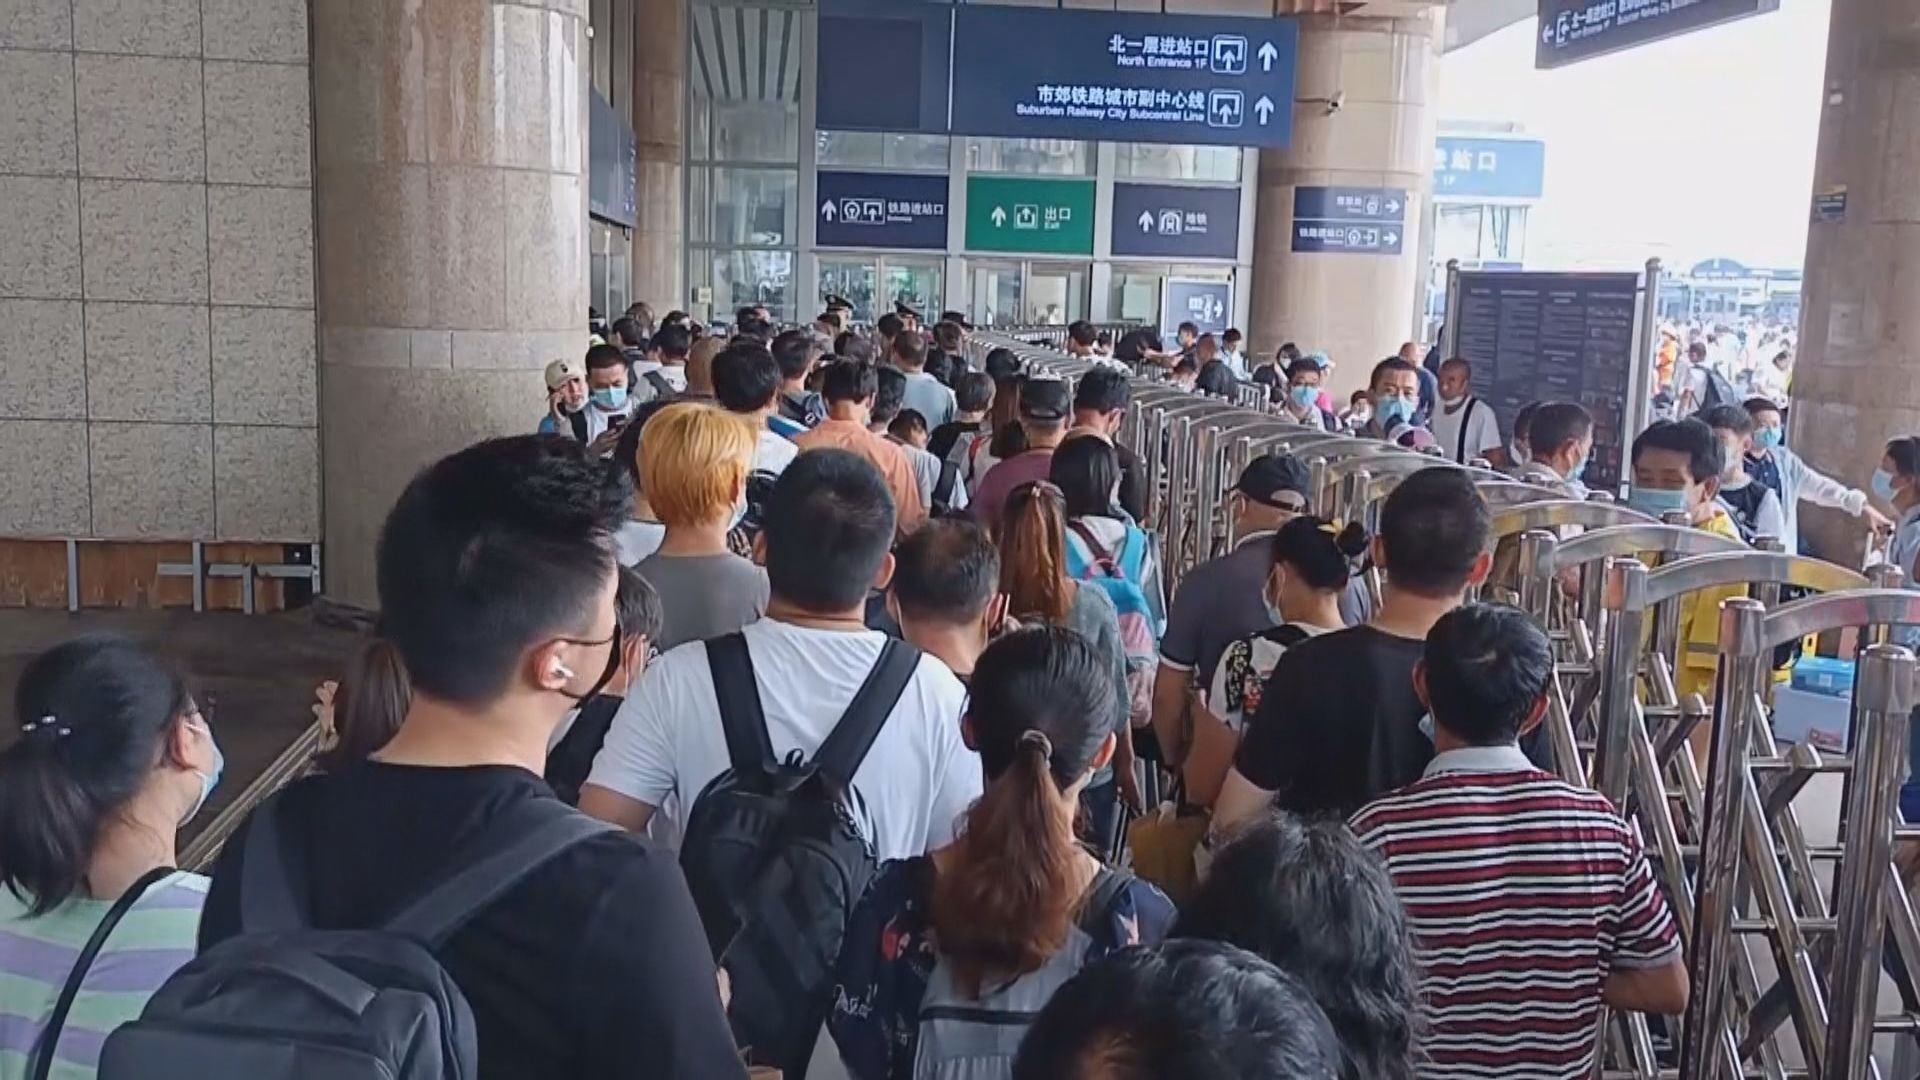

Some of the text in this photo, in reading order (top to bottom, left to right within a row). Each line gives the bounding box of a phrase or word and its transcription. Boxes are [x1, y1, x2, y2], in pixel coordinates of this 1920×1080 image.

[1109, 34, 1209, 56] 北一层进站口
[1117, 54, 1208, 69] North Entrance 1F
[1037, 84, 1205, 110] 市郊铁路城市副中心线
[1016, 104, 1205, 122] Suburban Railway City Subcentral Line
[1045, 205, 1071, 221] 出口
